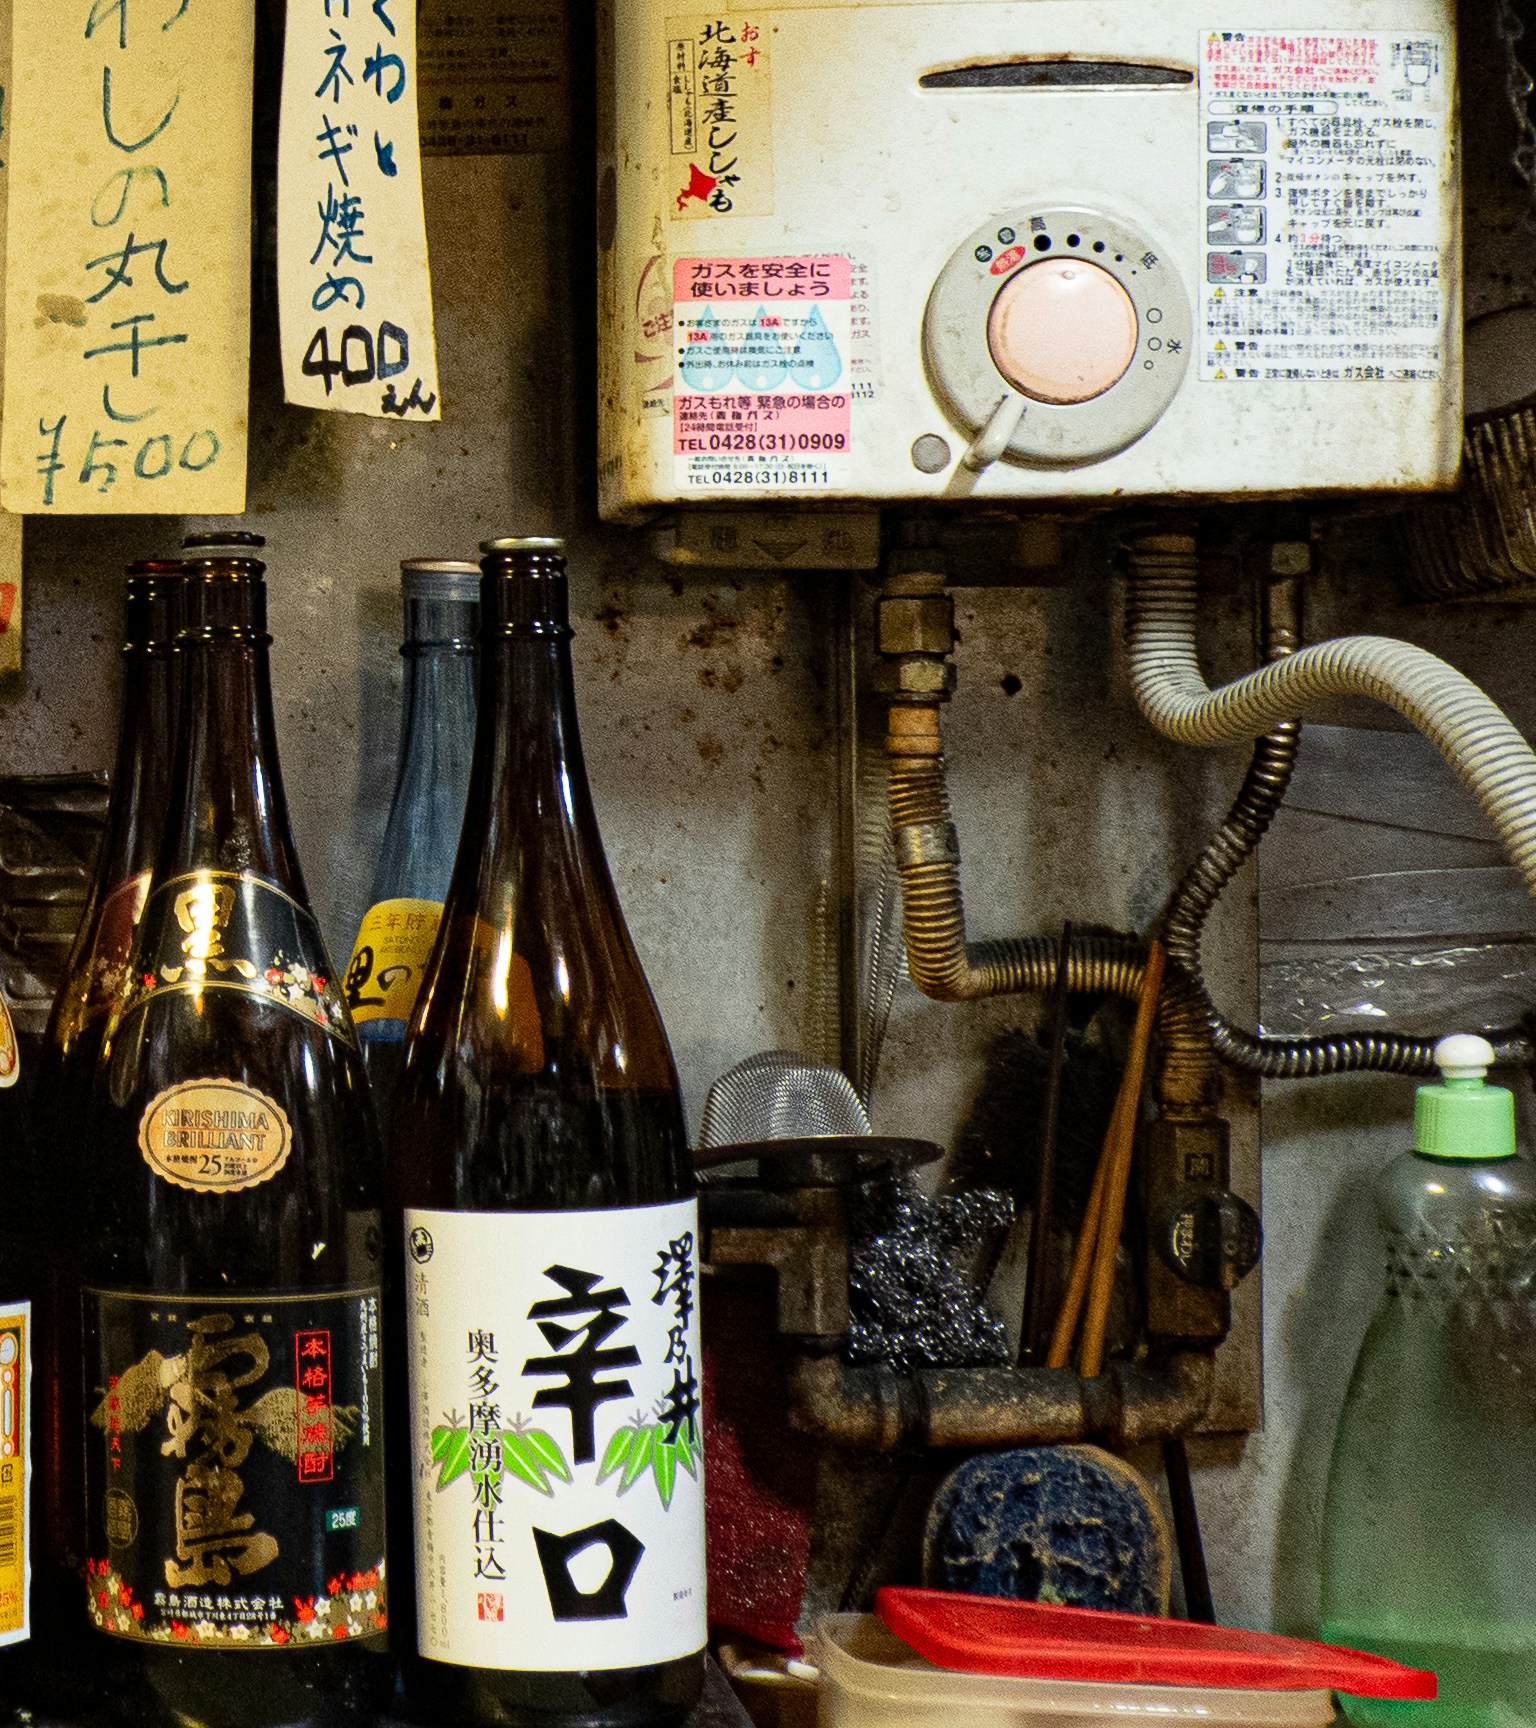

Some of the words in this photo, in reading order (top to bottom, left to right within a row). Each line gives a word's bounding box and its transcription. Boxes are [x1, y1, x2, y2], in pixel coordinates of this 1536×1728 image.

[690, 262, 832, 280] ガスを安全に
[689, 281, 832, 298] 使いましょう
[678, 437, 707, 452] TEL
[708, 433, 847, 452] 0428(31)0909
[344, 944, 426, 1012] 里の
[161, 1108, 271, 1132] KIRISHIMA
[162, 1129, 268, 1152] BRILLIANT
[198, 1153, 223, 1176] 25
[465, 1325, 508, 1583] 奥多摩湧水仕込
[519, 1262, 647, 1624] 辛口
